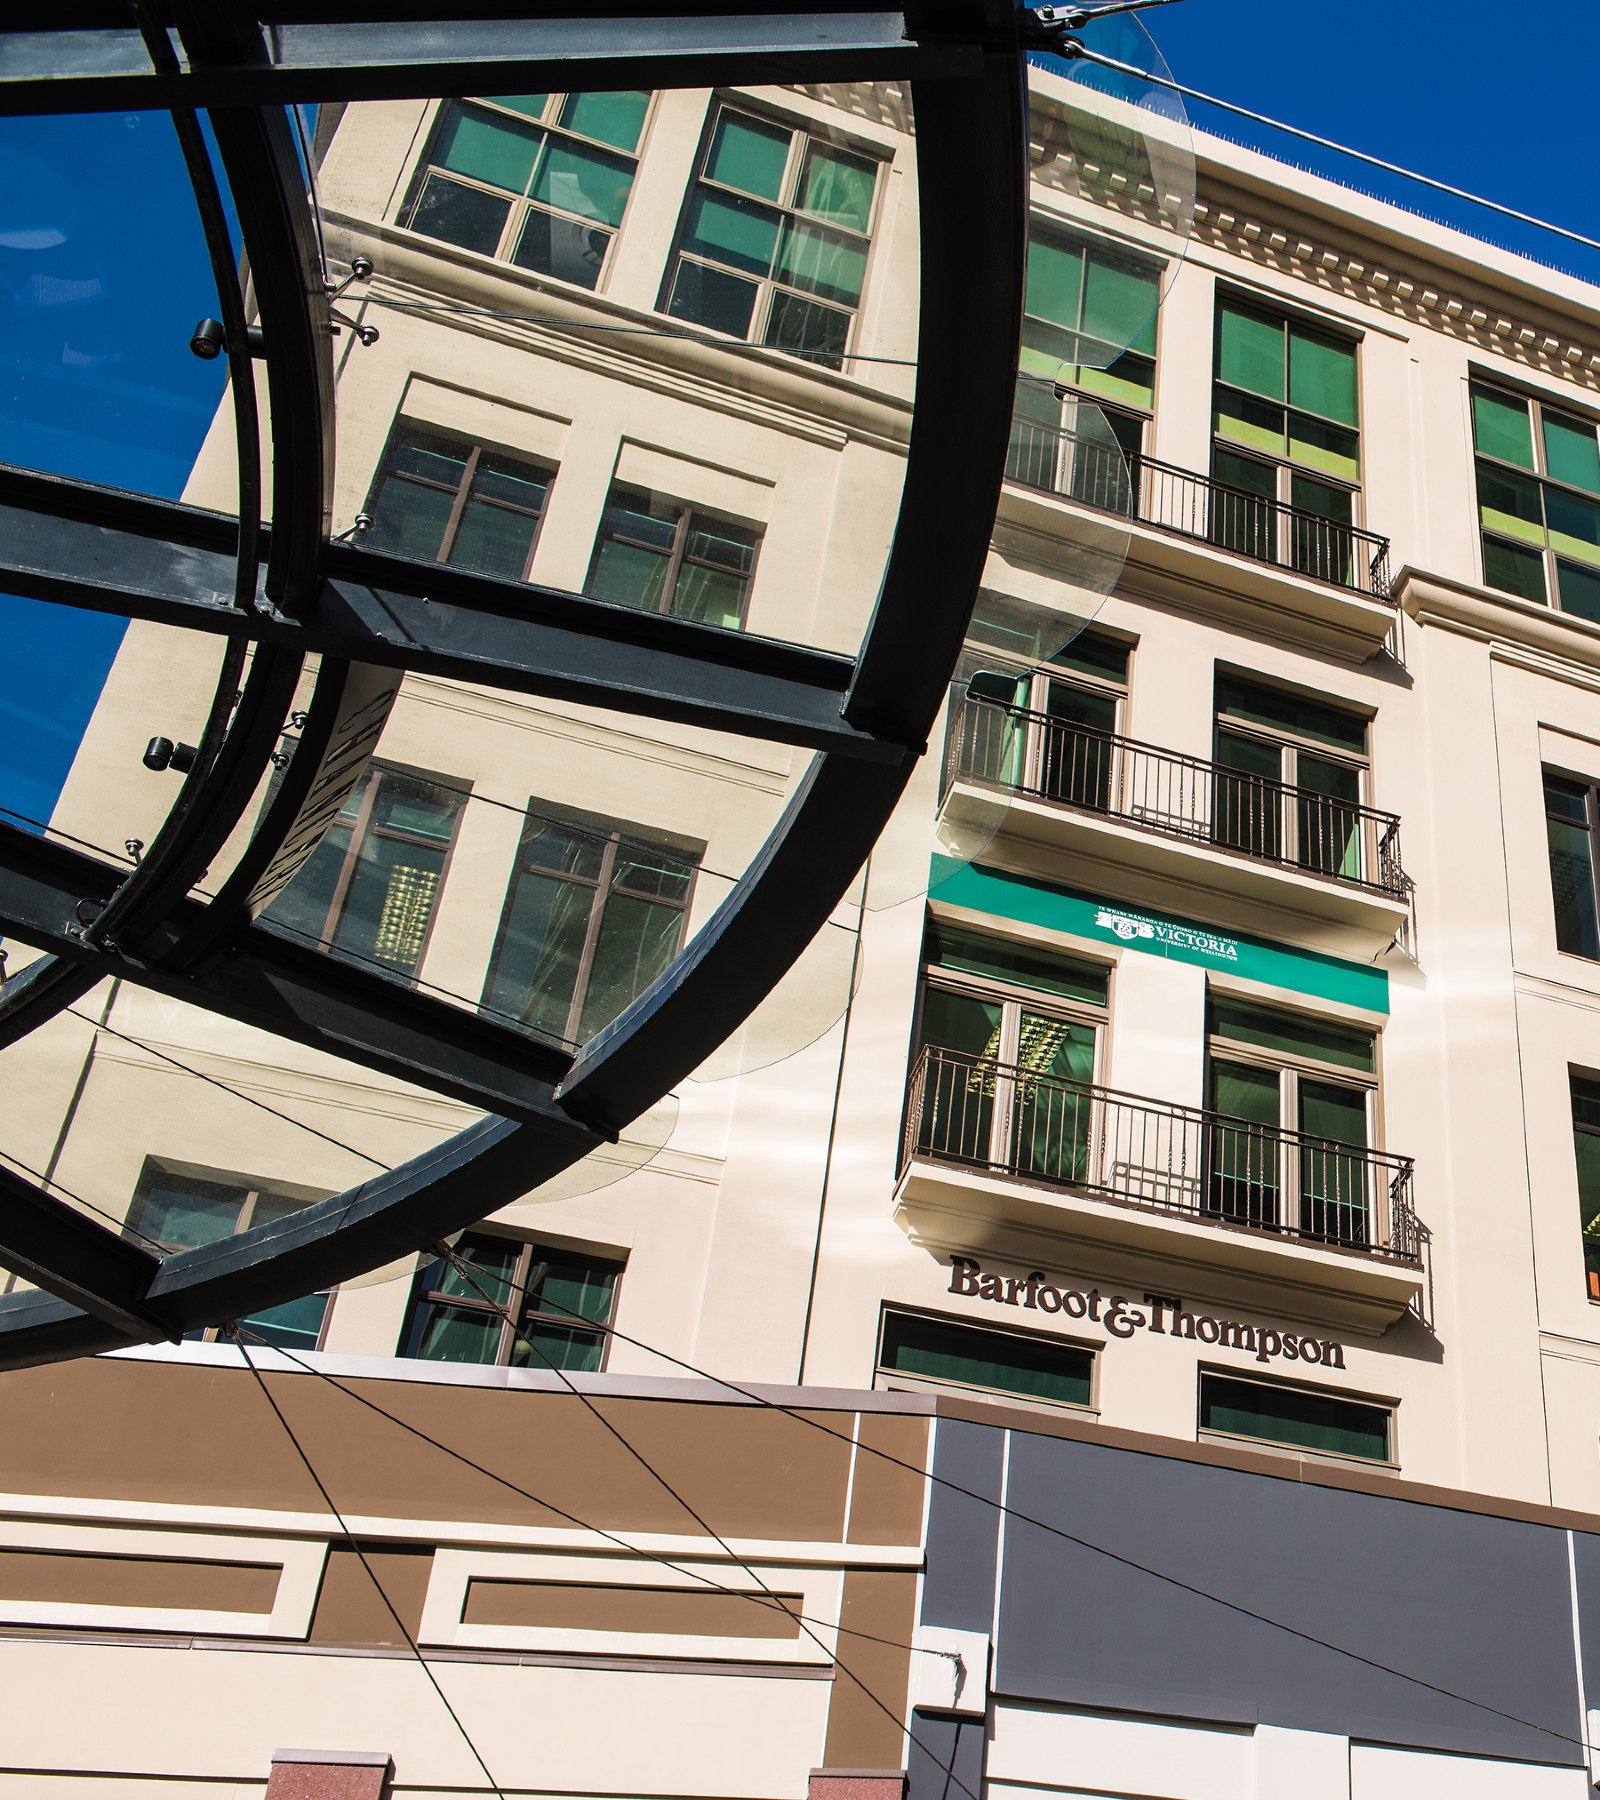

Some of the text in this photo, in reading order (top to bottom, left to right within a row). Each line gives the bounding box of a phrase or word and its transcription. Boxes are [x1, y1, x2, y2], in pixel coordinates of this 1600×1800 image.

[1155, 926, 1238, 956] VICTORIA
[1156, 937, 1191, 949] UNIVERSITY
[1200, 948, 1238, 961] WELLINGTON
